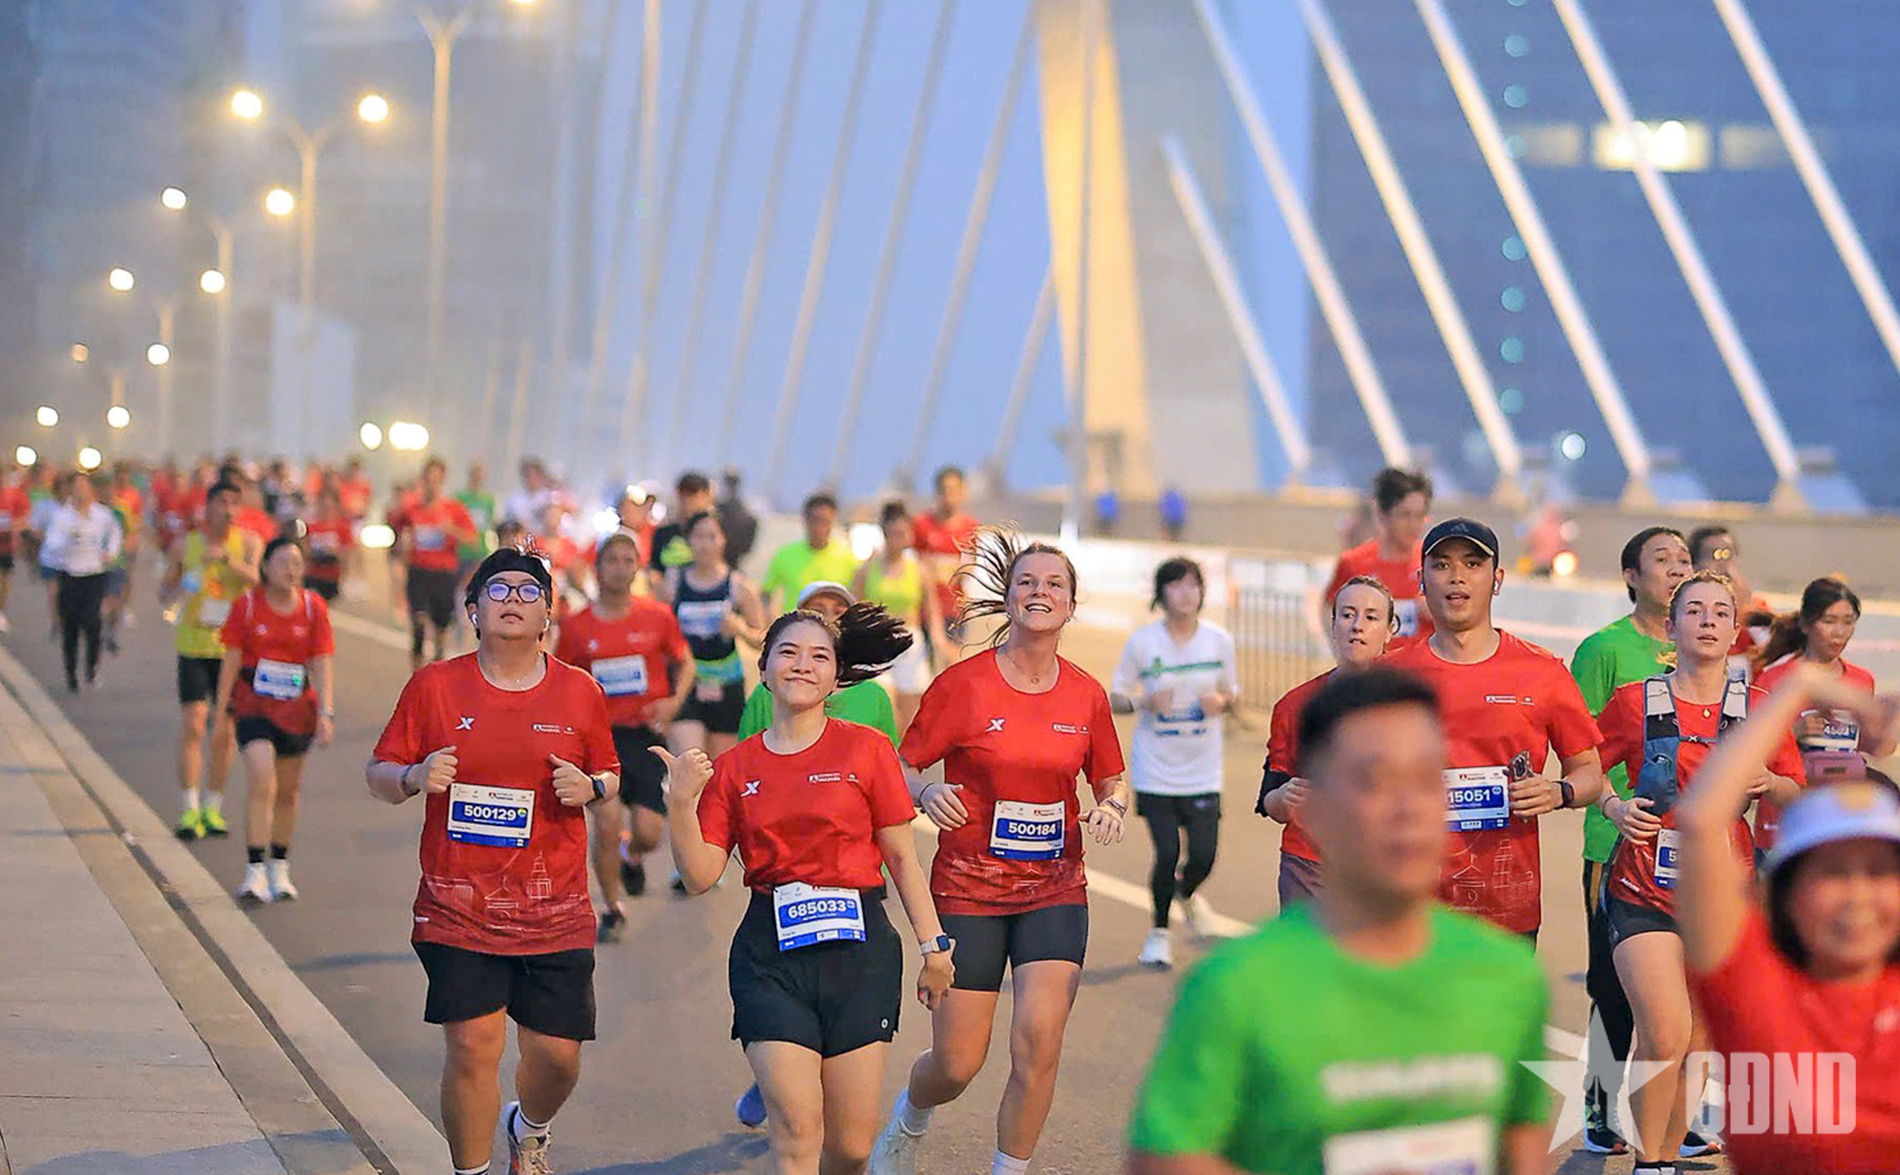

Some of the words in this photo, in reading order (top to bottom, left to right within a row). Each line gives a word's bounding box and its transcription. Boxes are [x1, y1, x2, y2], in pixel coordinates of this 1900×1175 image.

[1447, 789, 1491, 803] 15051
[464, 804, 517, 821] 500129
[1008, 822, 1057, 836] 500184
[787, 899, 847, 919] 685033
